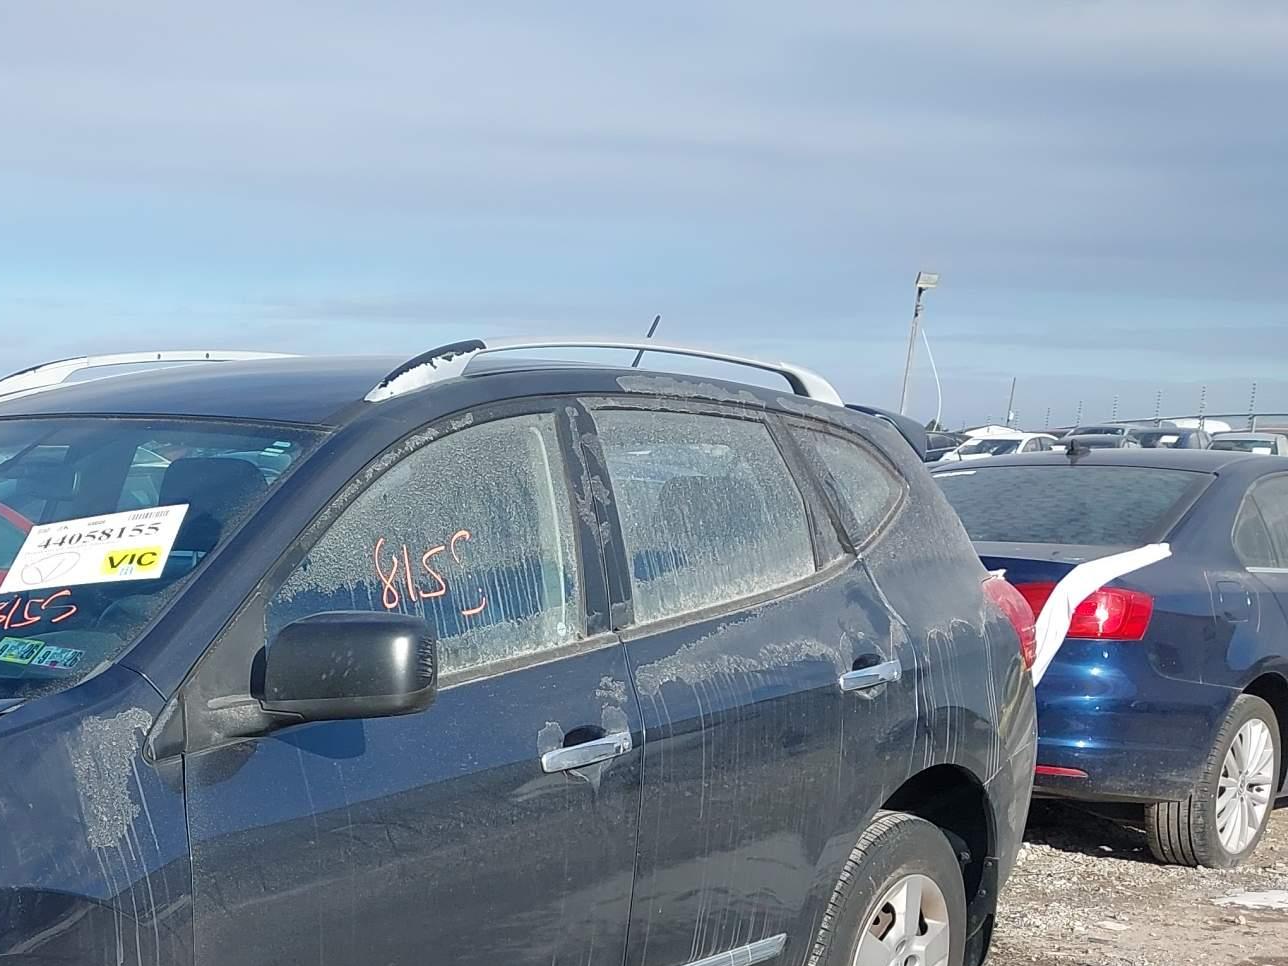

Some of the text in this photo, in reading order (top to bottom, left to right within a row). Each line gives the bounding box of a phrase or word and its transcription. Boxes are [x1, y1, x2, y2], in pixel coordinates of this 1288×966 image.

[37, 522, 162, 550] 44058155
[108, 552, 158, 569] VIC
[374, 529, 487, 616] 8155
